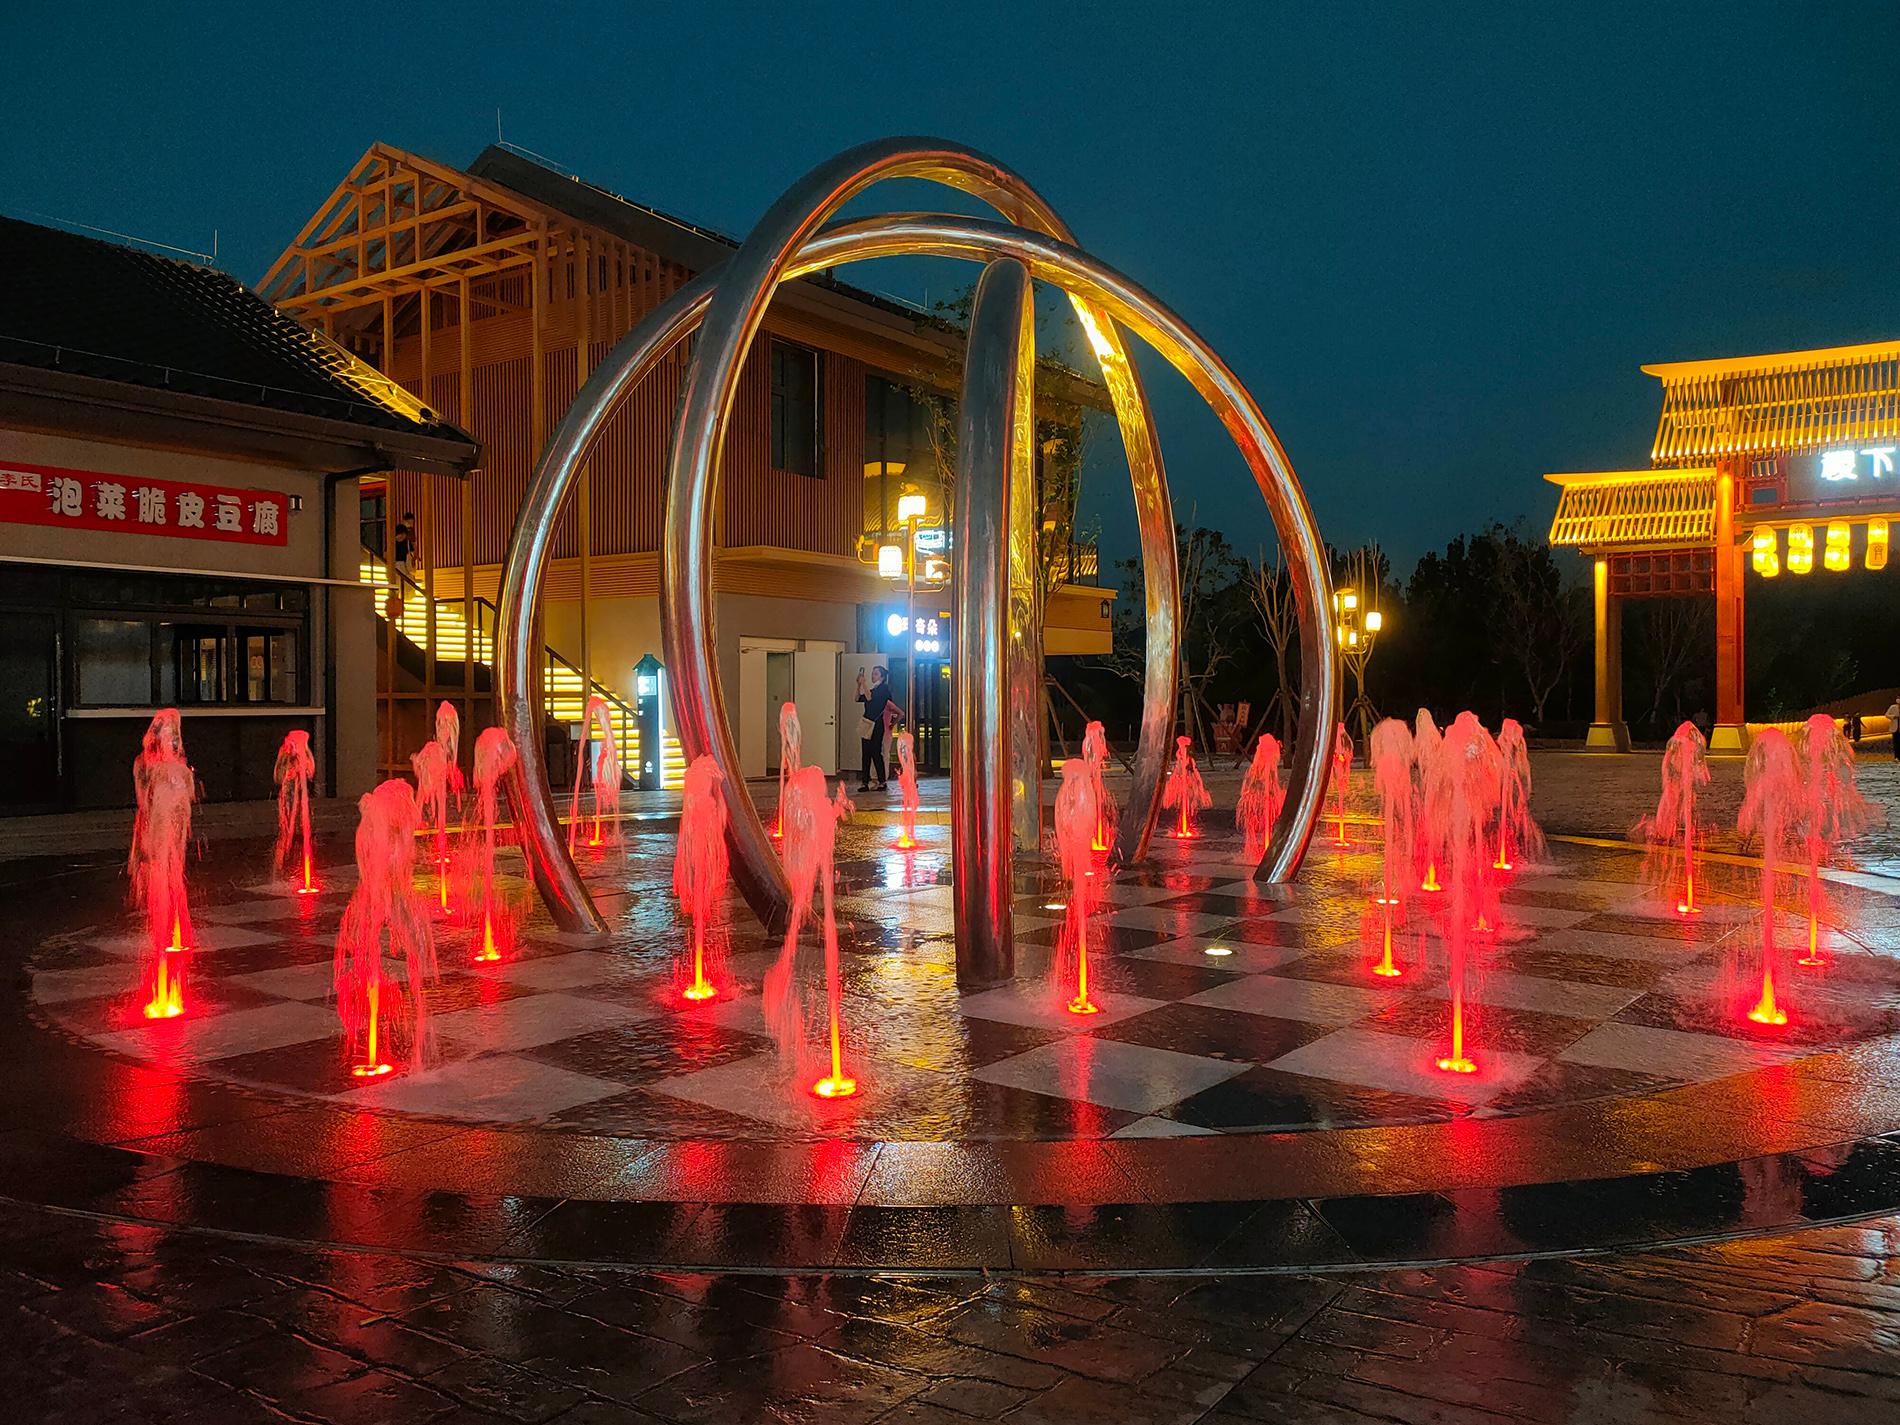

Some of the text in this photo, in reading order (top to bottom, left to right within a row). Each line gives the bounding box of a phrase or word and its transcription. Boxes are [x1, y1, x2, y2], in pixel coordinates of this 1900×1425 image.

[52, 477, 280, 536] 泡菜脆皮豆腐
